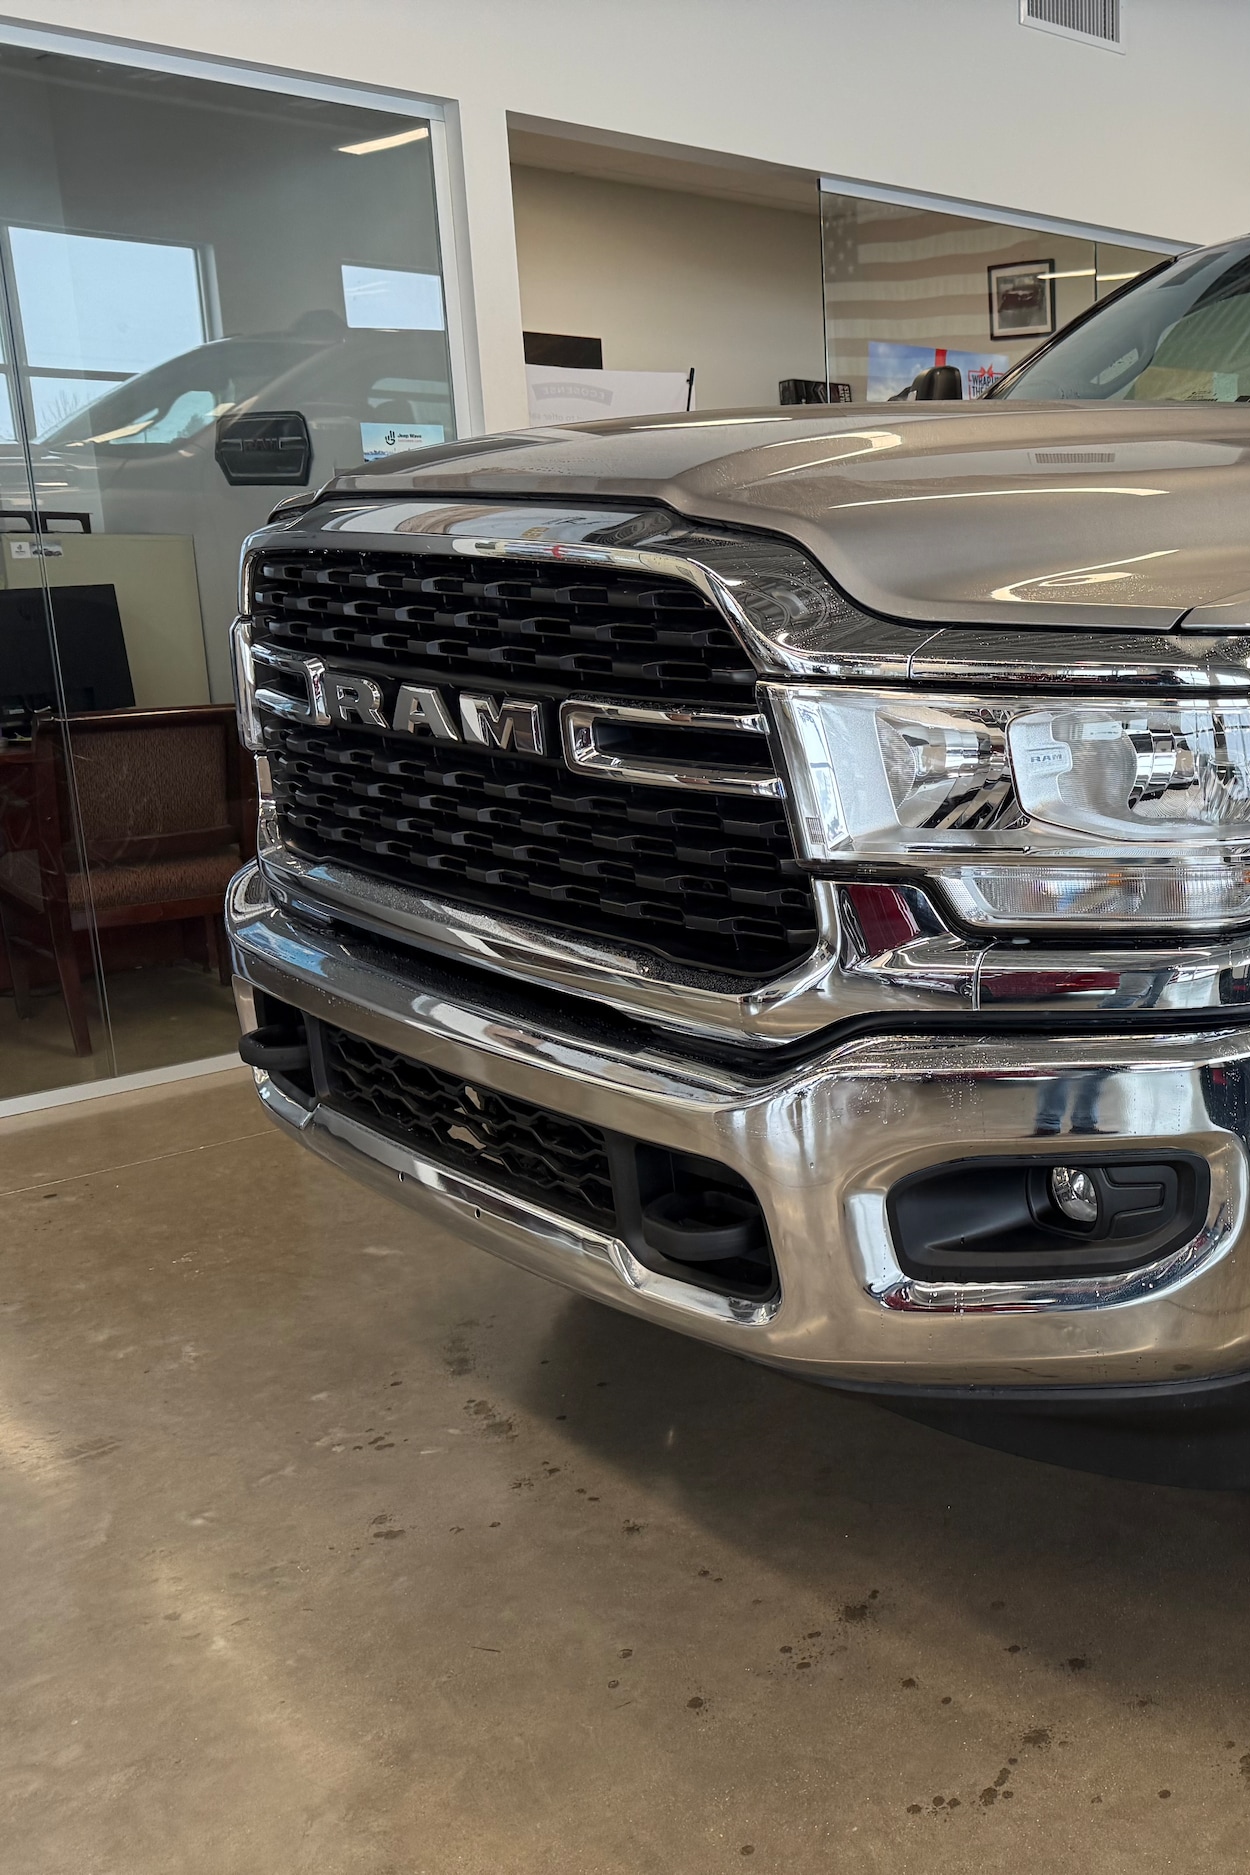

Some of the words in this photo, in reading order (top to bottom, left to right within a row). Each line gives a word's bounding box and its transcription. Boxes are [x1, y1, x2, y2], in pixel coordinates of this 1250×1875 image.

[971, 374, 991, 387] WRAP
[326, 671, 548, 757] RAM
[1030, 753, 1062, 763] RAM
